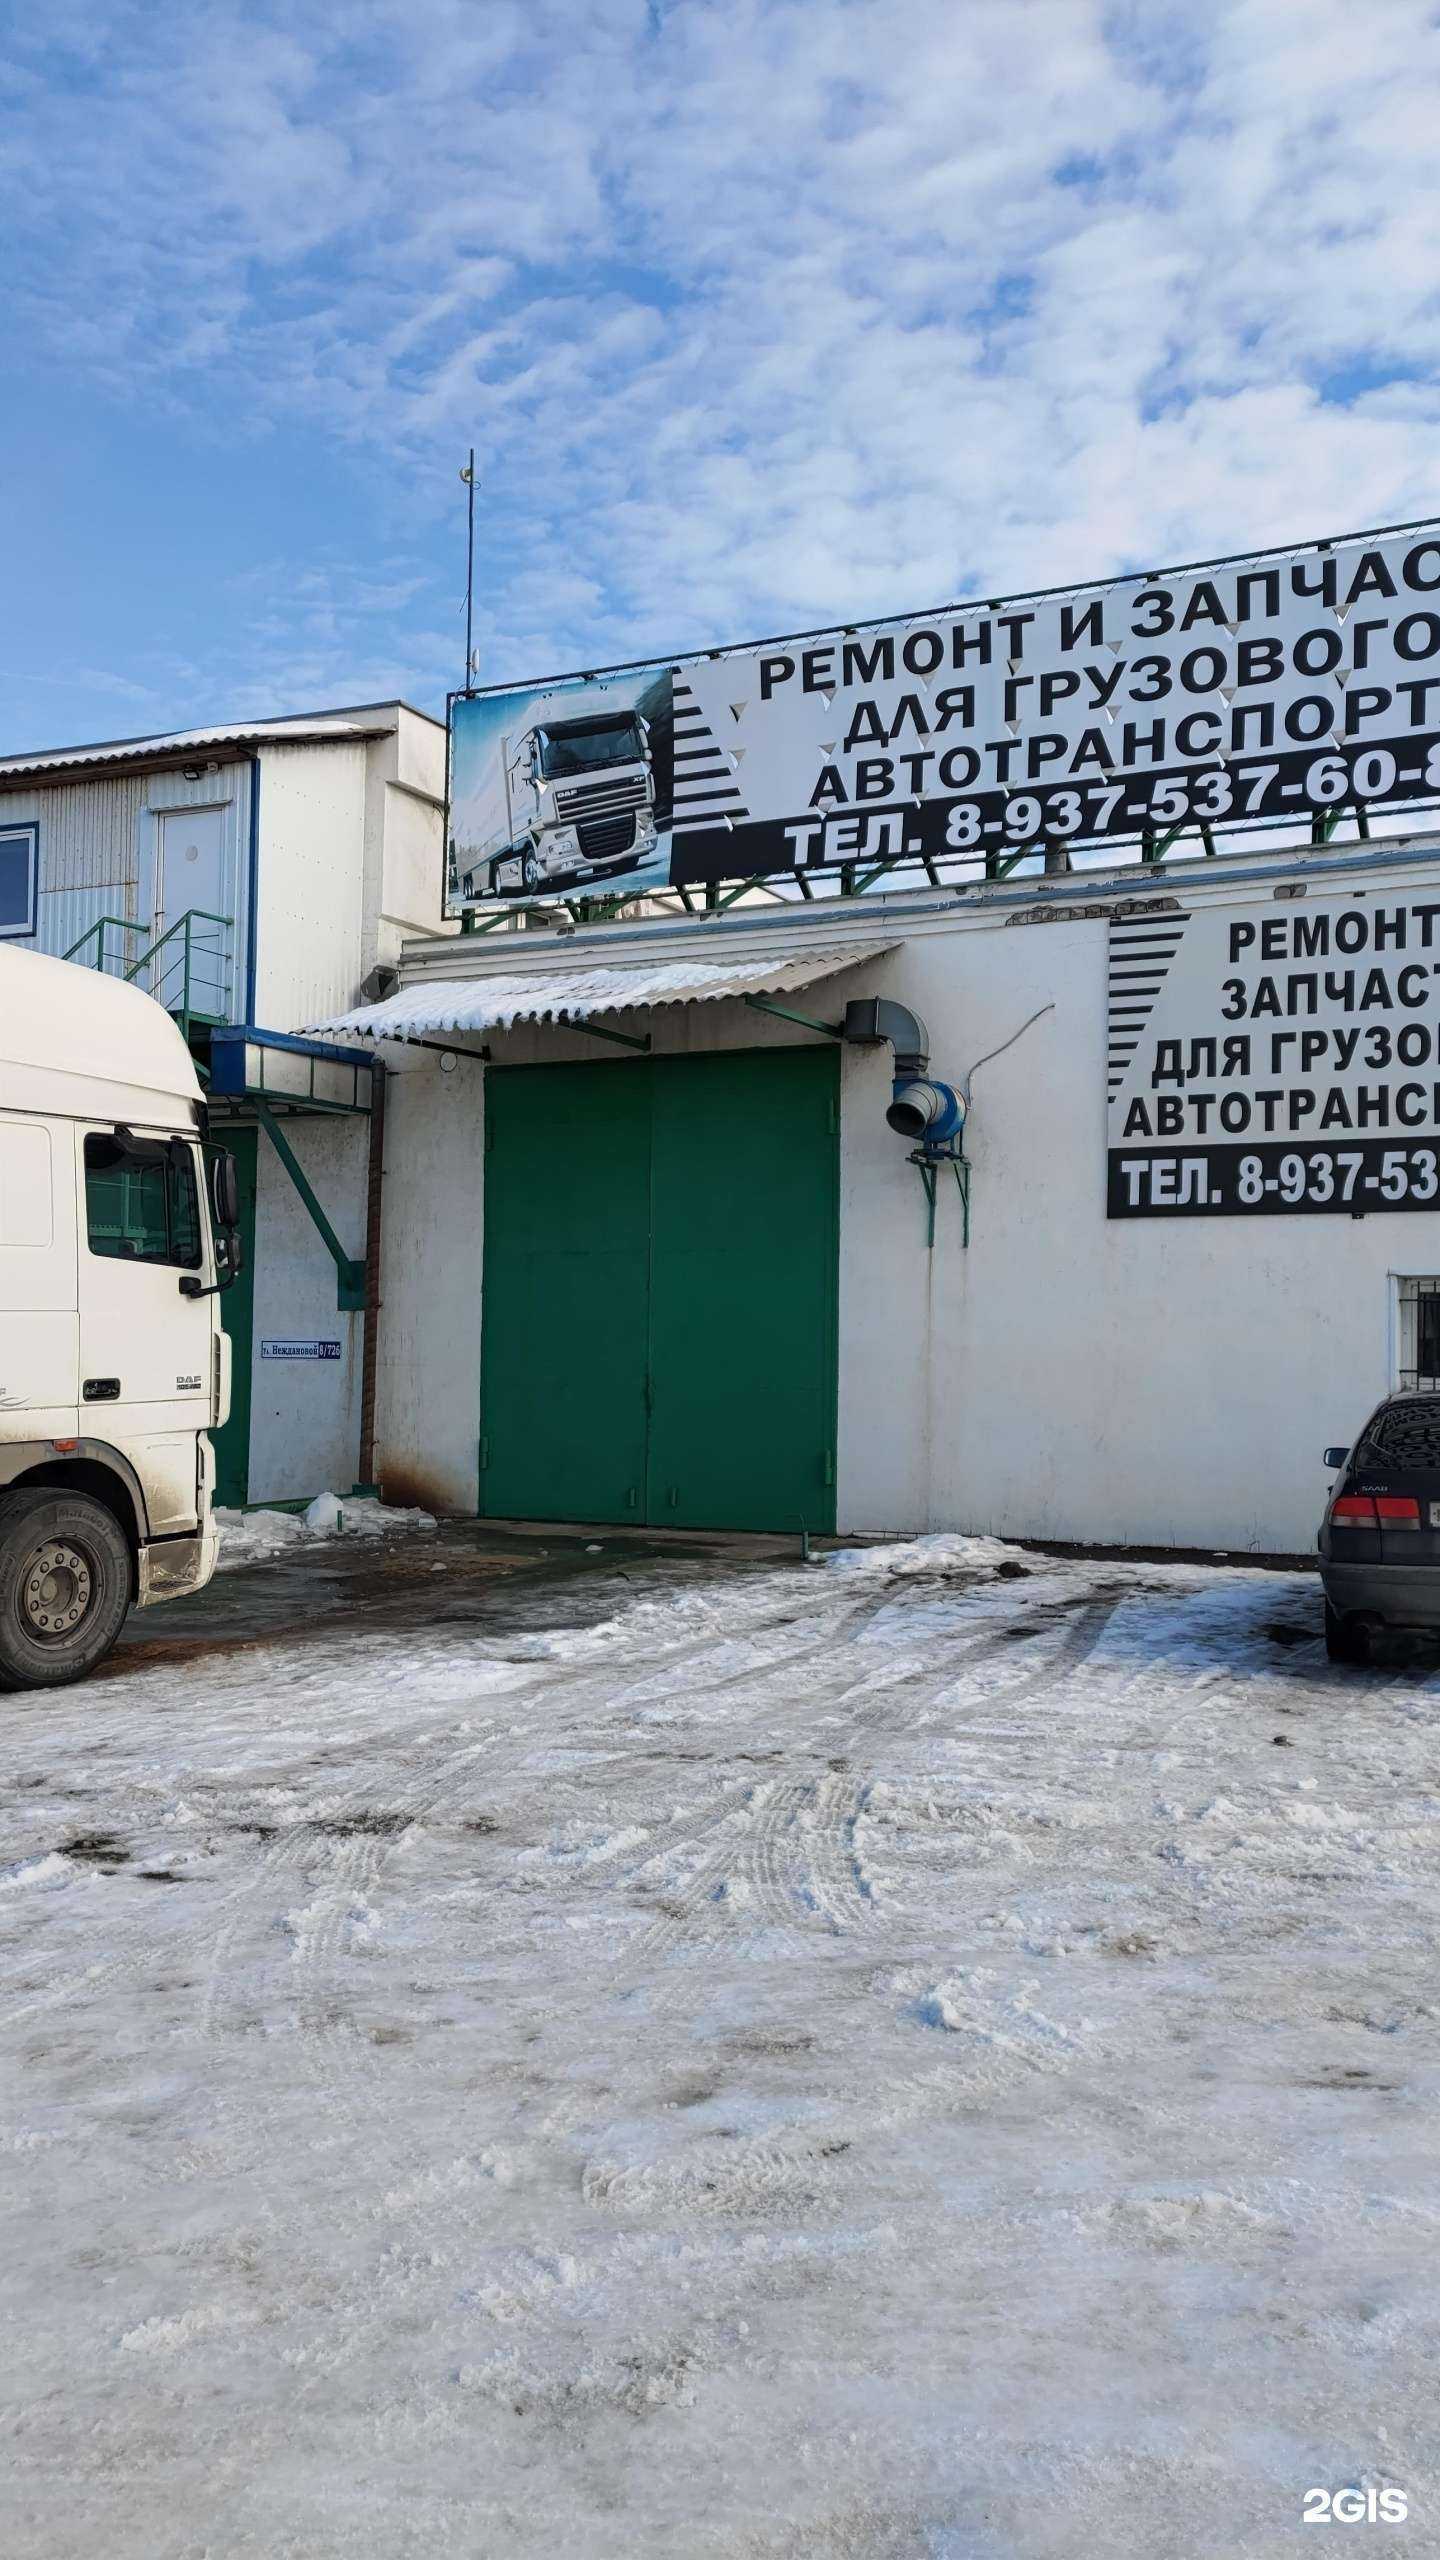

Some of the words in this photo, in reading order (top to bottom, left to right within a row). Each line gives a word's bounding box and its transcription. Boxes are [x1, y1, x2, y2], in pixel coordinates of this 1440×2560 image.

[760, 613, 1035, 701] РЕМОНТ
[1060, 602, 1103, 653] И
[1131, 541, 1440, 638] ЗАПЧАС
[844, 685, 976, 753] ДЛЯ
[1004, 611, 1440, 718] ГРУЗОВОГО
[810, 677, 1440, 807] АВТОТРАНСПОРТ
[785, 813, 923, 866] ТЕЛ.
[1229, 904, 1440, 963] РЕМОНТ
[1221, 963, 1440, 1021] ЗАПЧАС
[1151, 1034, 1251, 1089] ДЛЯ
[1271, 1022, 1440, 1075] ГРУЗО
[1122, 1082, 1440, 1138] АВТОТРАНС
[1121, 1157, 1222, 1206] ТЕЛ.
[1237, 1150, 1440, 1204] 8-937-53
[176, 1375, 202, 1384] DAF
